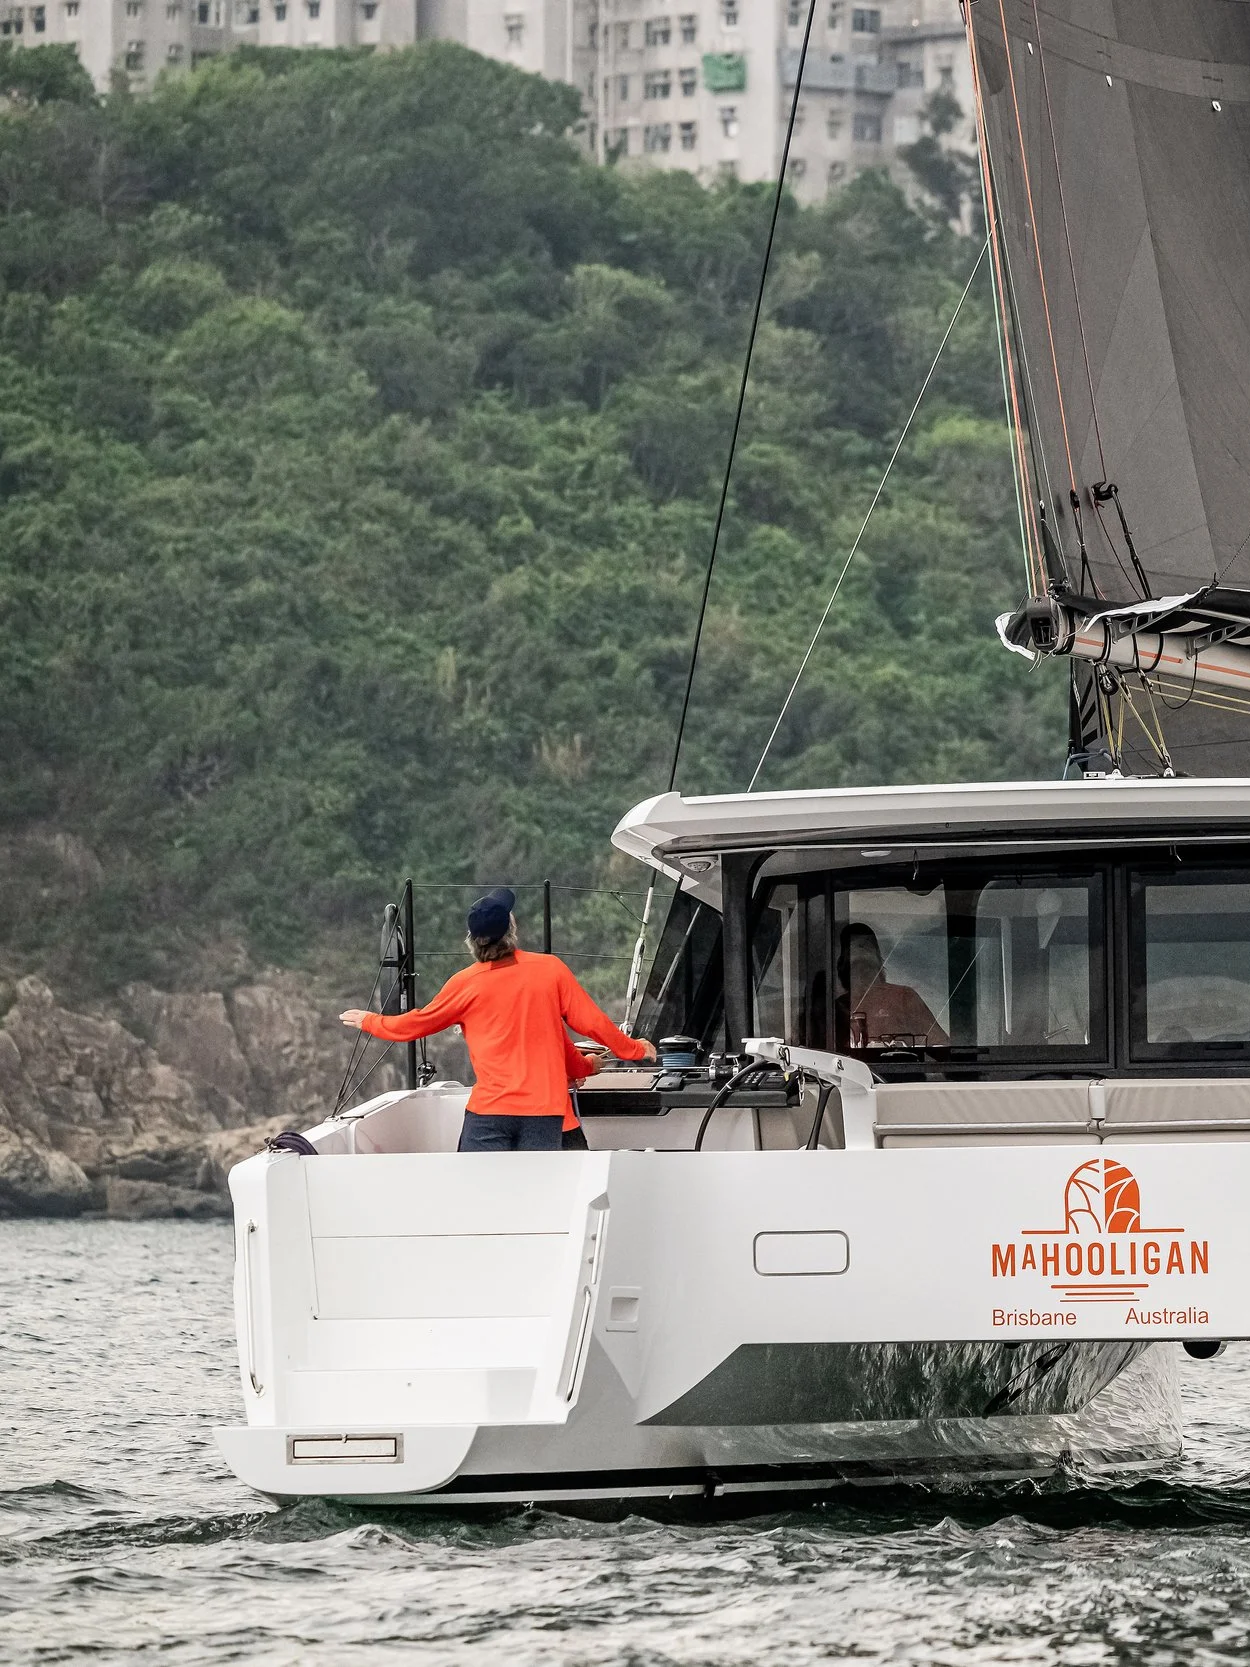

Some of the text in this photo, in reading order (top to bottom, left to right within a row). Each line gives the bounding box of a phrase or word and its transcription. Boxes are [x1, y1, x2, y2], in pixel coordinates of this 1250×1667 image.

[991, 1240, 1209, 1277] MAHOOLIGAN
[992, 1307, 1209, 1326] Brisbane Australia
